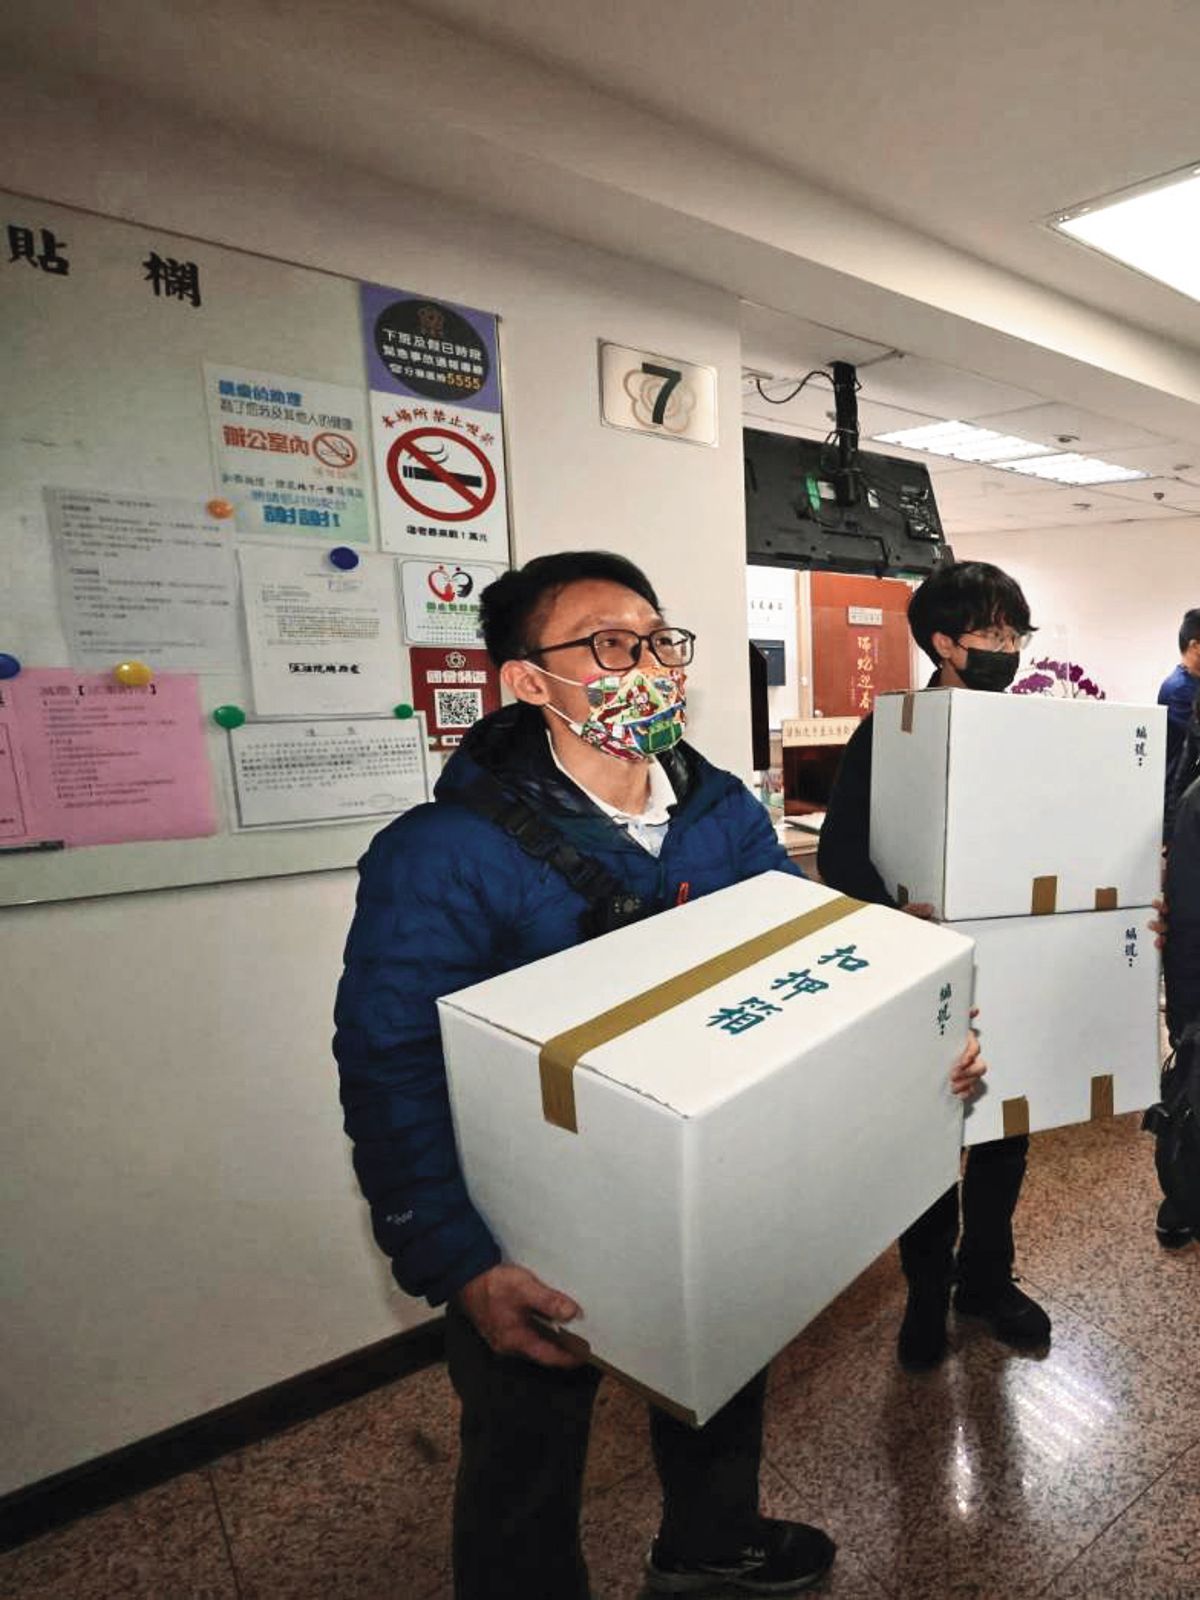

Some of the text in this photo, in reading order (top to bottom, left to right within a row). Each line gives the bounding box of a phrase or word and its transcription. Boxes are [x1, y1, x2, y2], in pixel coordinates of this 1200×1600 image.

[7, 222, 202, 308] 貼欄
[642, 363, 682, 425] 7
[223, 425, 310, 456] 辦公室內
[704, 944, 870, 1036] 扣押箱
